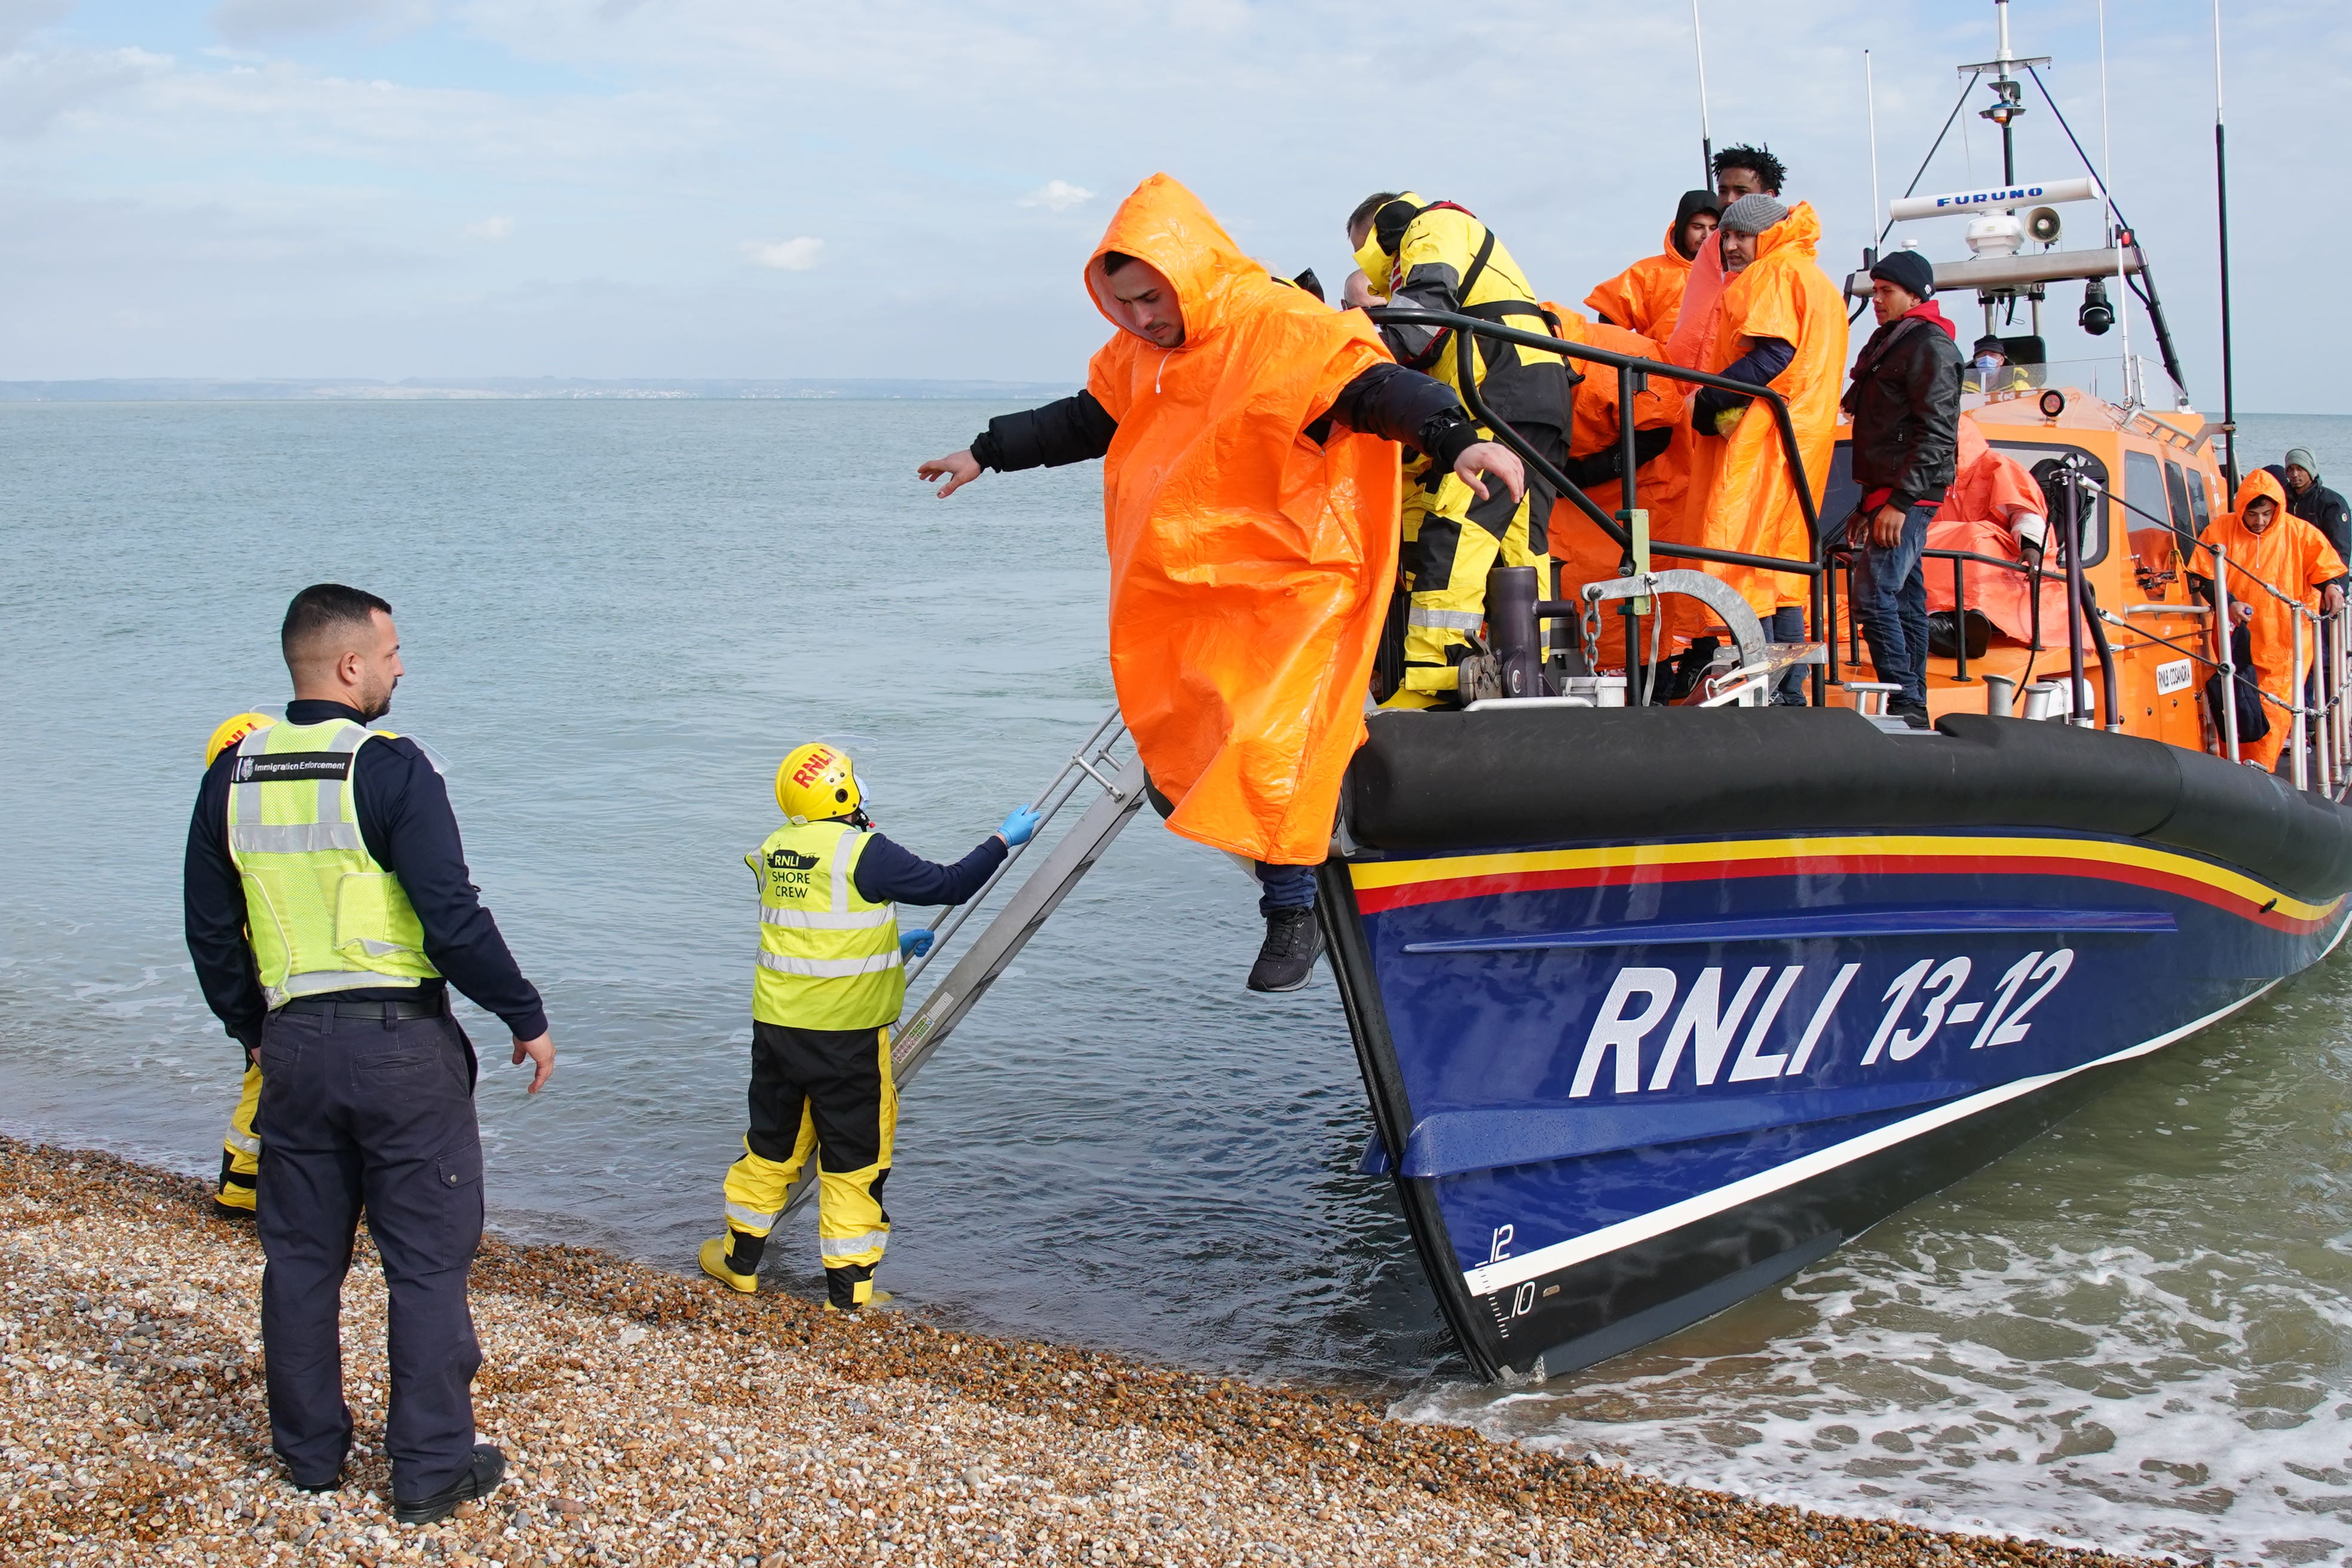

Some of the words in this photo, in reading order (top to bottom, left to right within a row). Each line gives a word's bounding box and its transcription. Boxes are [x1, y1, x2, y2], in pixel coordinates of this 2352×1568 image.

[1937, 188, 2042, 207] FURUNO
[254, 762, 298, 773] Immigration
[299, 761, 346, 770] Enforcement
[792, 748, 837, 789] RNLI
[774, 855, 800, 867] RNLI
[772, 871, 811, 884] SHORE
[776, 886, 808, 899] CREW
[1569, 963, 1862, 1098] RNLI
[1860, 948, 2075, 1066] 13-12
[1489, 1224, 1514, 1263] 12
[1511, 1281, 1536, 1318] 10
